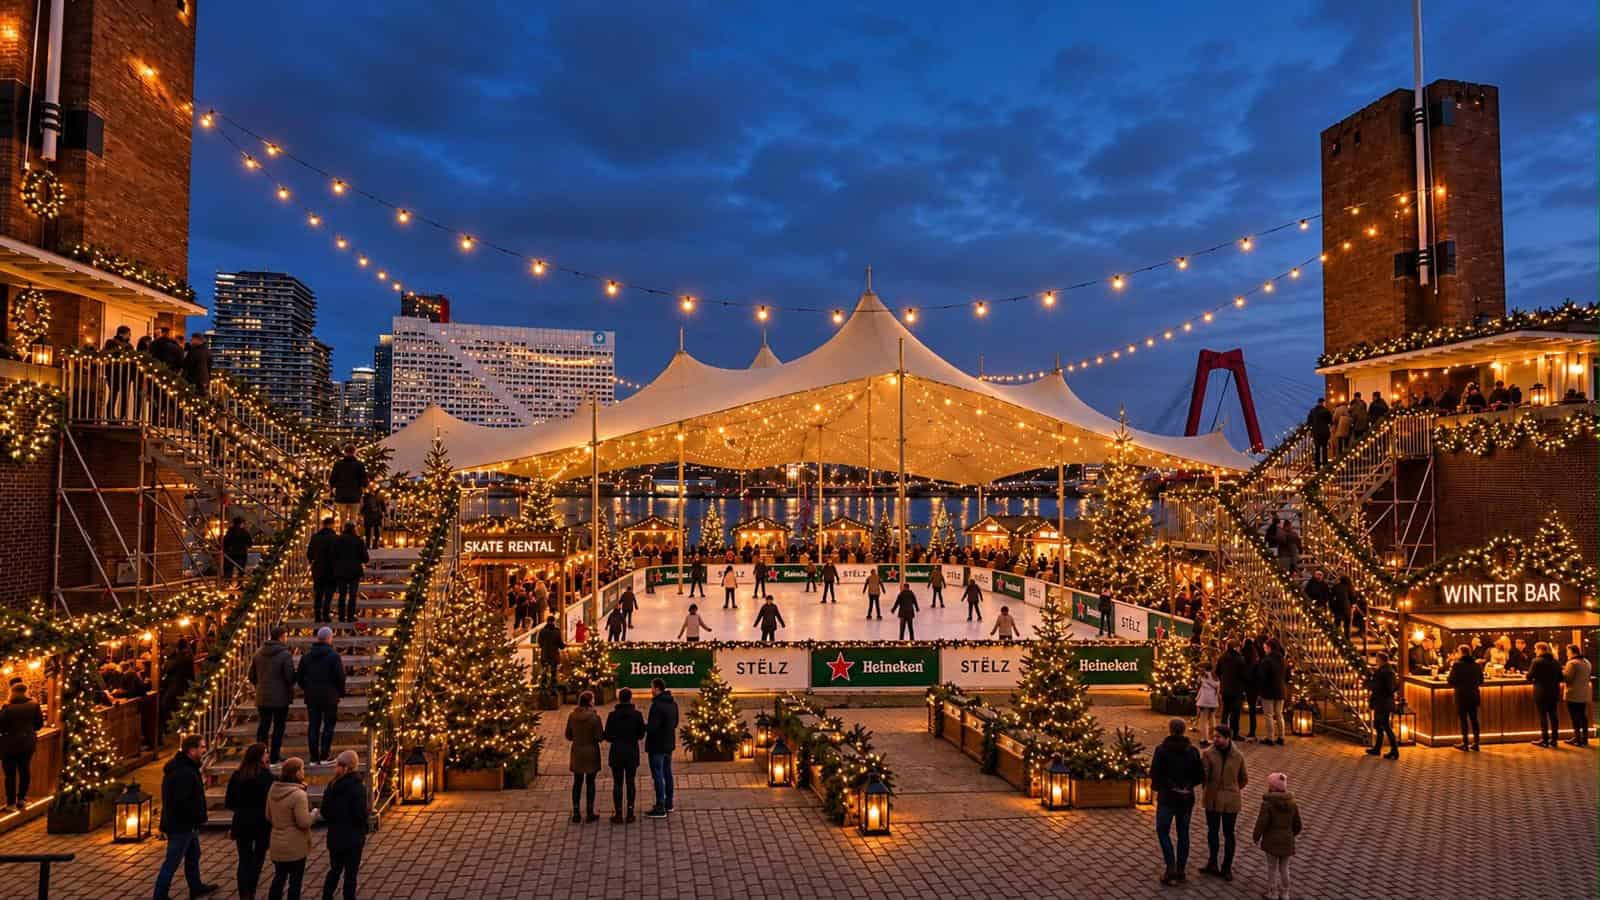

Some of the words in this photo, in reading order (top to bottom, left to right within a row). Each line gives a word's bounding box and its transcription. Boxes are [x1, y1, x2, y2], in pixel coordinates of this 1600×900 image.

[464, 541, 504, 553] SKATE
[508, 541, 555, 552] RENTAL
[1443, 584, 1518, 604] WINTER
[1524, 583, 1561, 603] BAR
[630, 662, 693, 674] Heineken
[736, 659, 788, 674] STËLZ
[863, 661, 923, 673] Heineken
[961, 658, 1010, 673] STËLZ
[1079, 659, 1137, 672] Heineken
